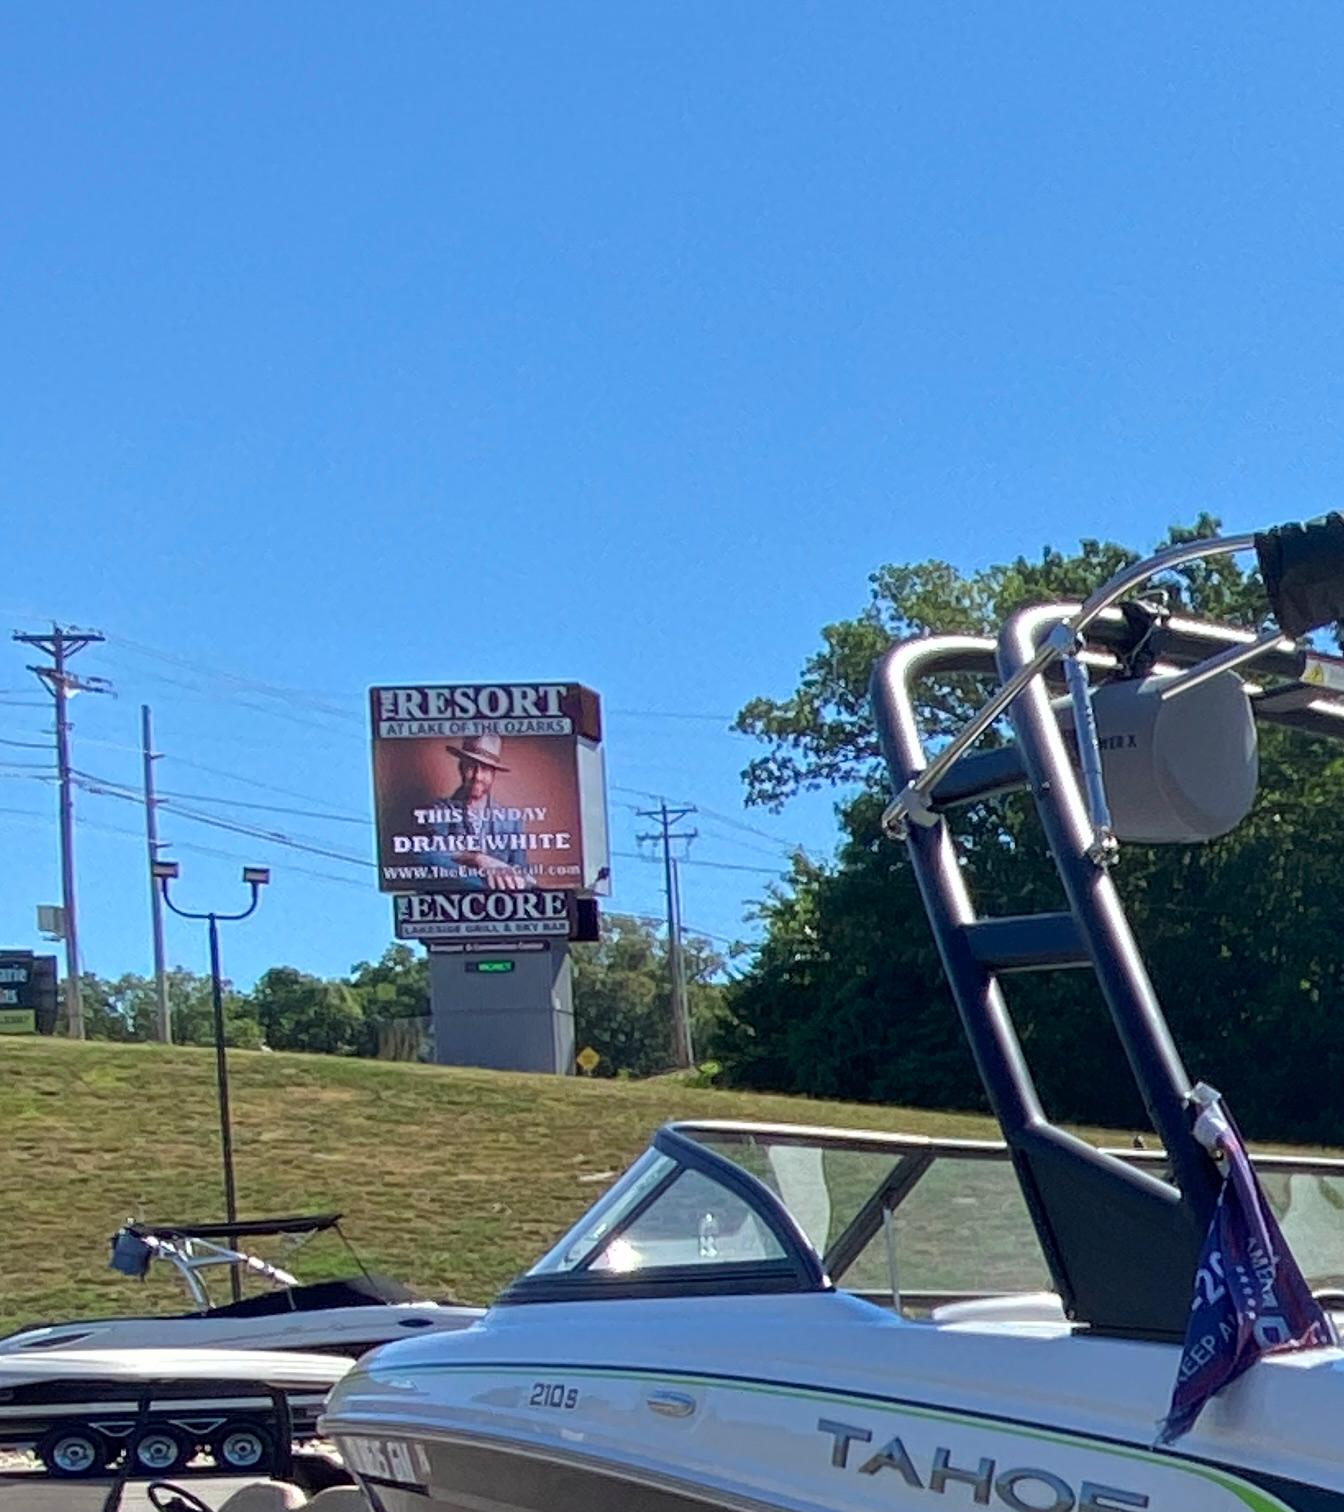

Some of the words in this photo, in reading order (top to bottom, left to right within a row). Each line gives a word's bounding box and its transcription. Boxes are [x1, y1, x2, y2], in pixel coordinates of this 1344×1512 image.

[395, 686, 567, 720] RESORT
[386, 723, 405, 736] AT
[407, 722, 445, 736] LAKE
[450, 721, 469, 735] OF
[473, 721, 501, 735] THE
[504, 720, 565, 734] OZARKS
[413, 808, 463, 825] THIS
[467, 807, 548, 823] SUNDAY
[393, 834, 480, 853] DRAKE
[482, 832, 572, 851] WHITE
[411, 891, 568, 922] ENCORE
